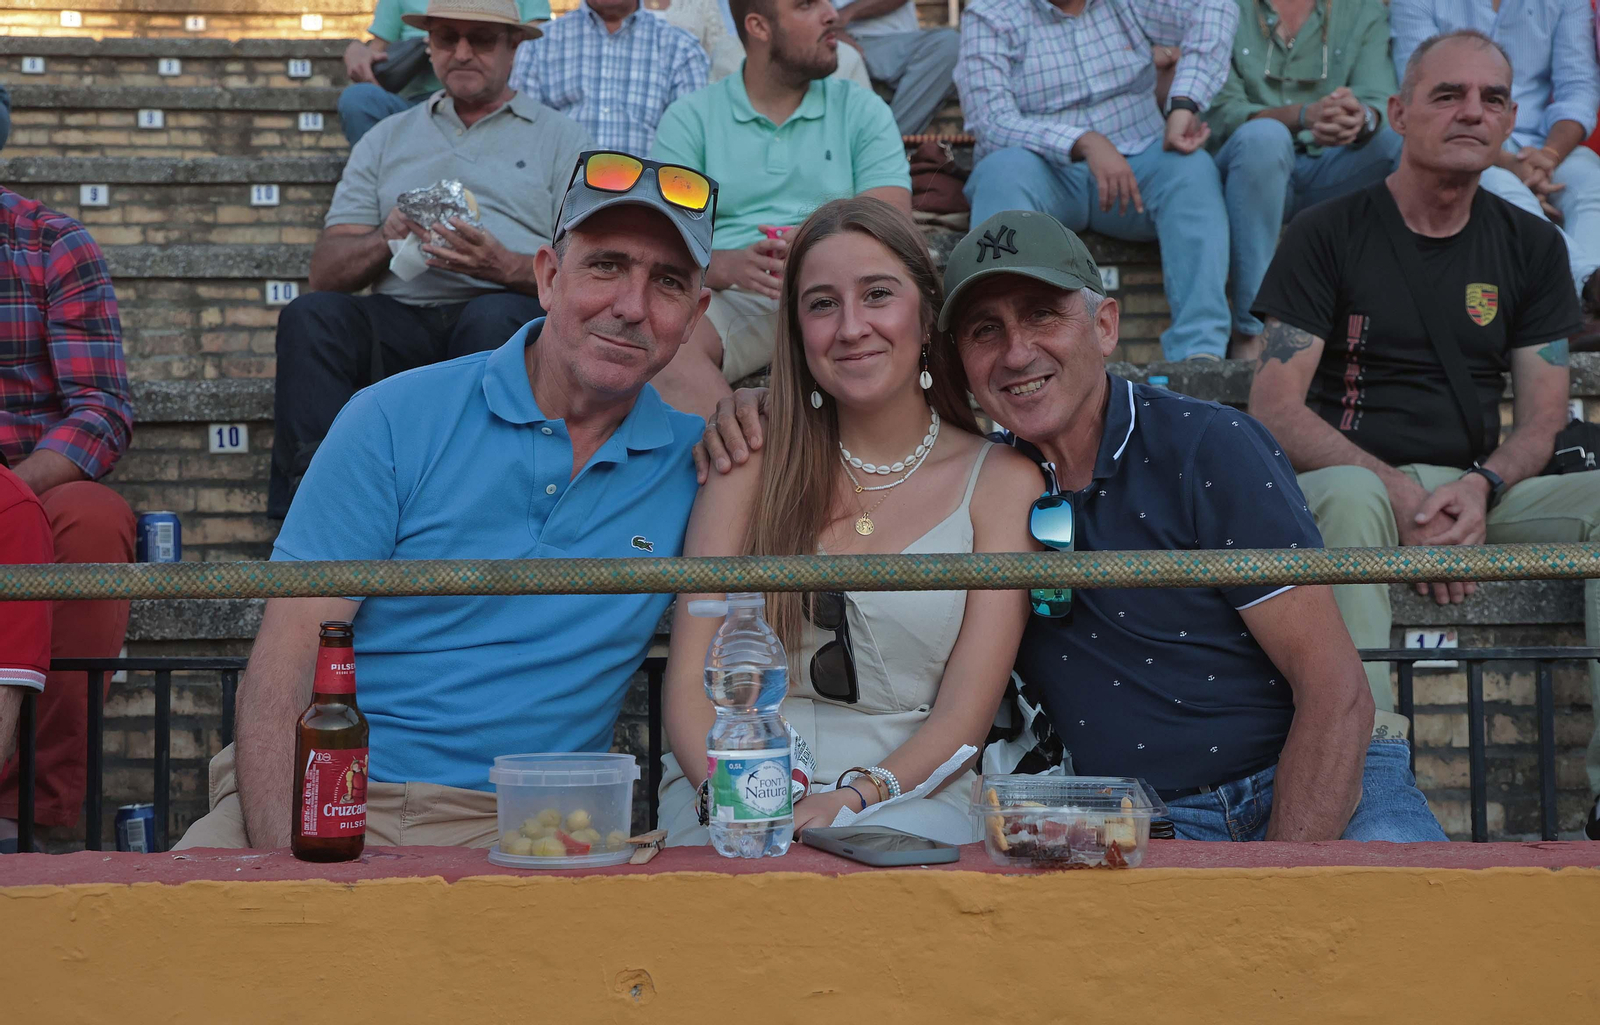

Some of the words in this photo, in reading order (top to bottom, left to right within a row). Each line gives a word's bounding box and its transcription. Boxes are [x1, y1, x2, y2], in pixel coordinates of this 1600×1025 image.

[90, 186, 98, 202] 9
[256, 185, 274, 201] 10
[976, 224, 1019, 263] NY
[273, 283, 292, 301] 10
[216, 426, 240, 449] 10
[728, 763, 743, 771] 0,5L
[760, 777, 783, 788] FONT
[745, 785, 787, 800] Natura
